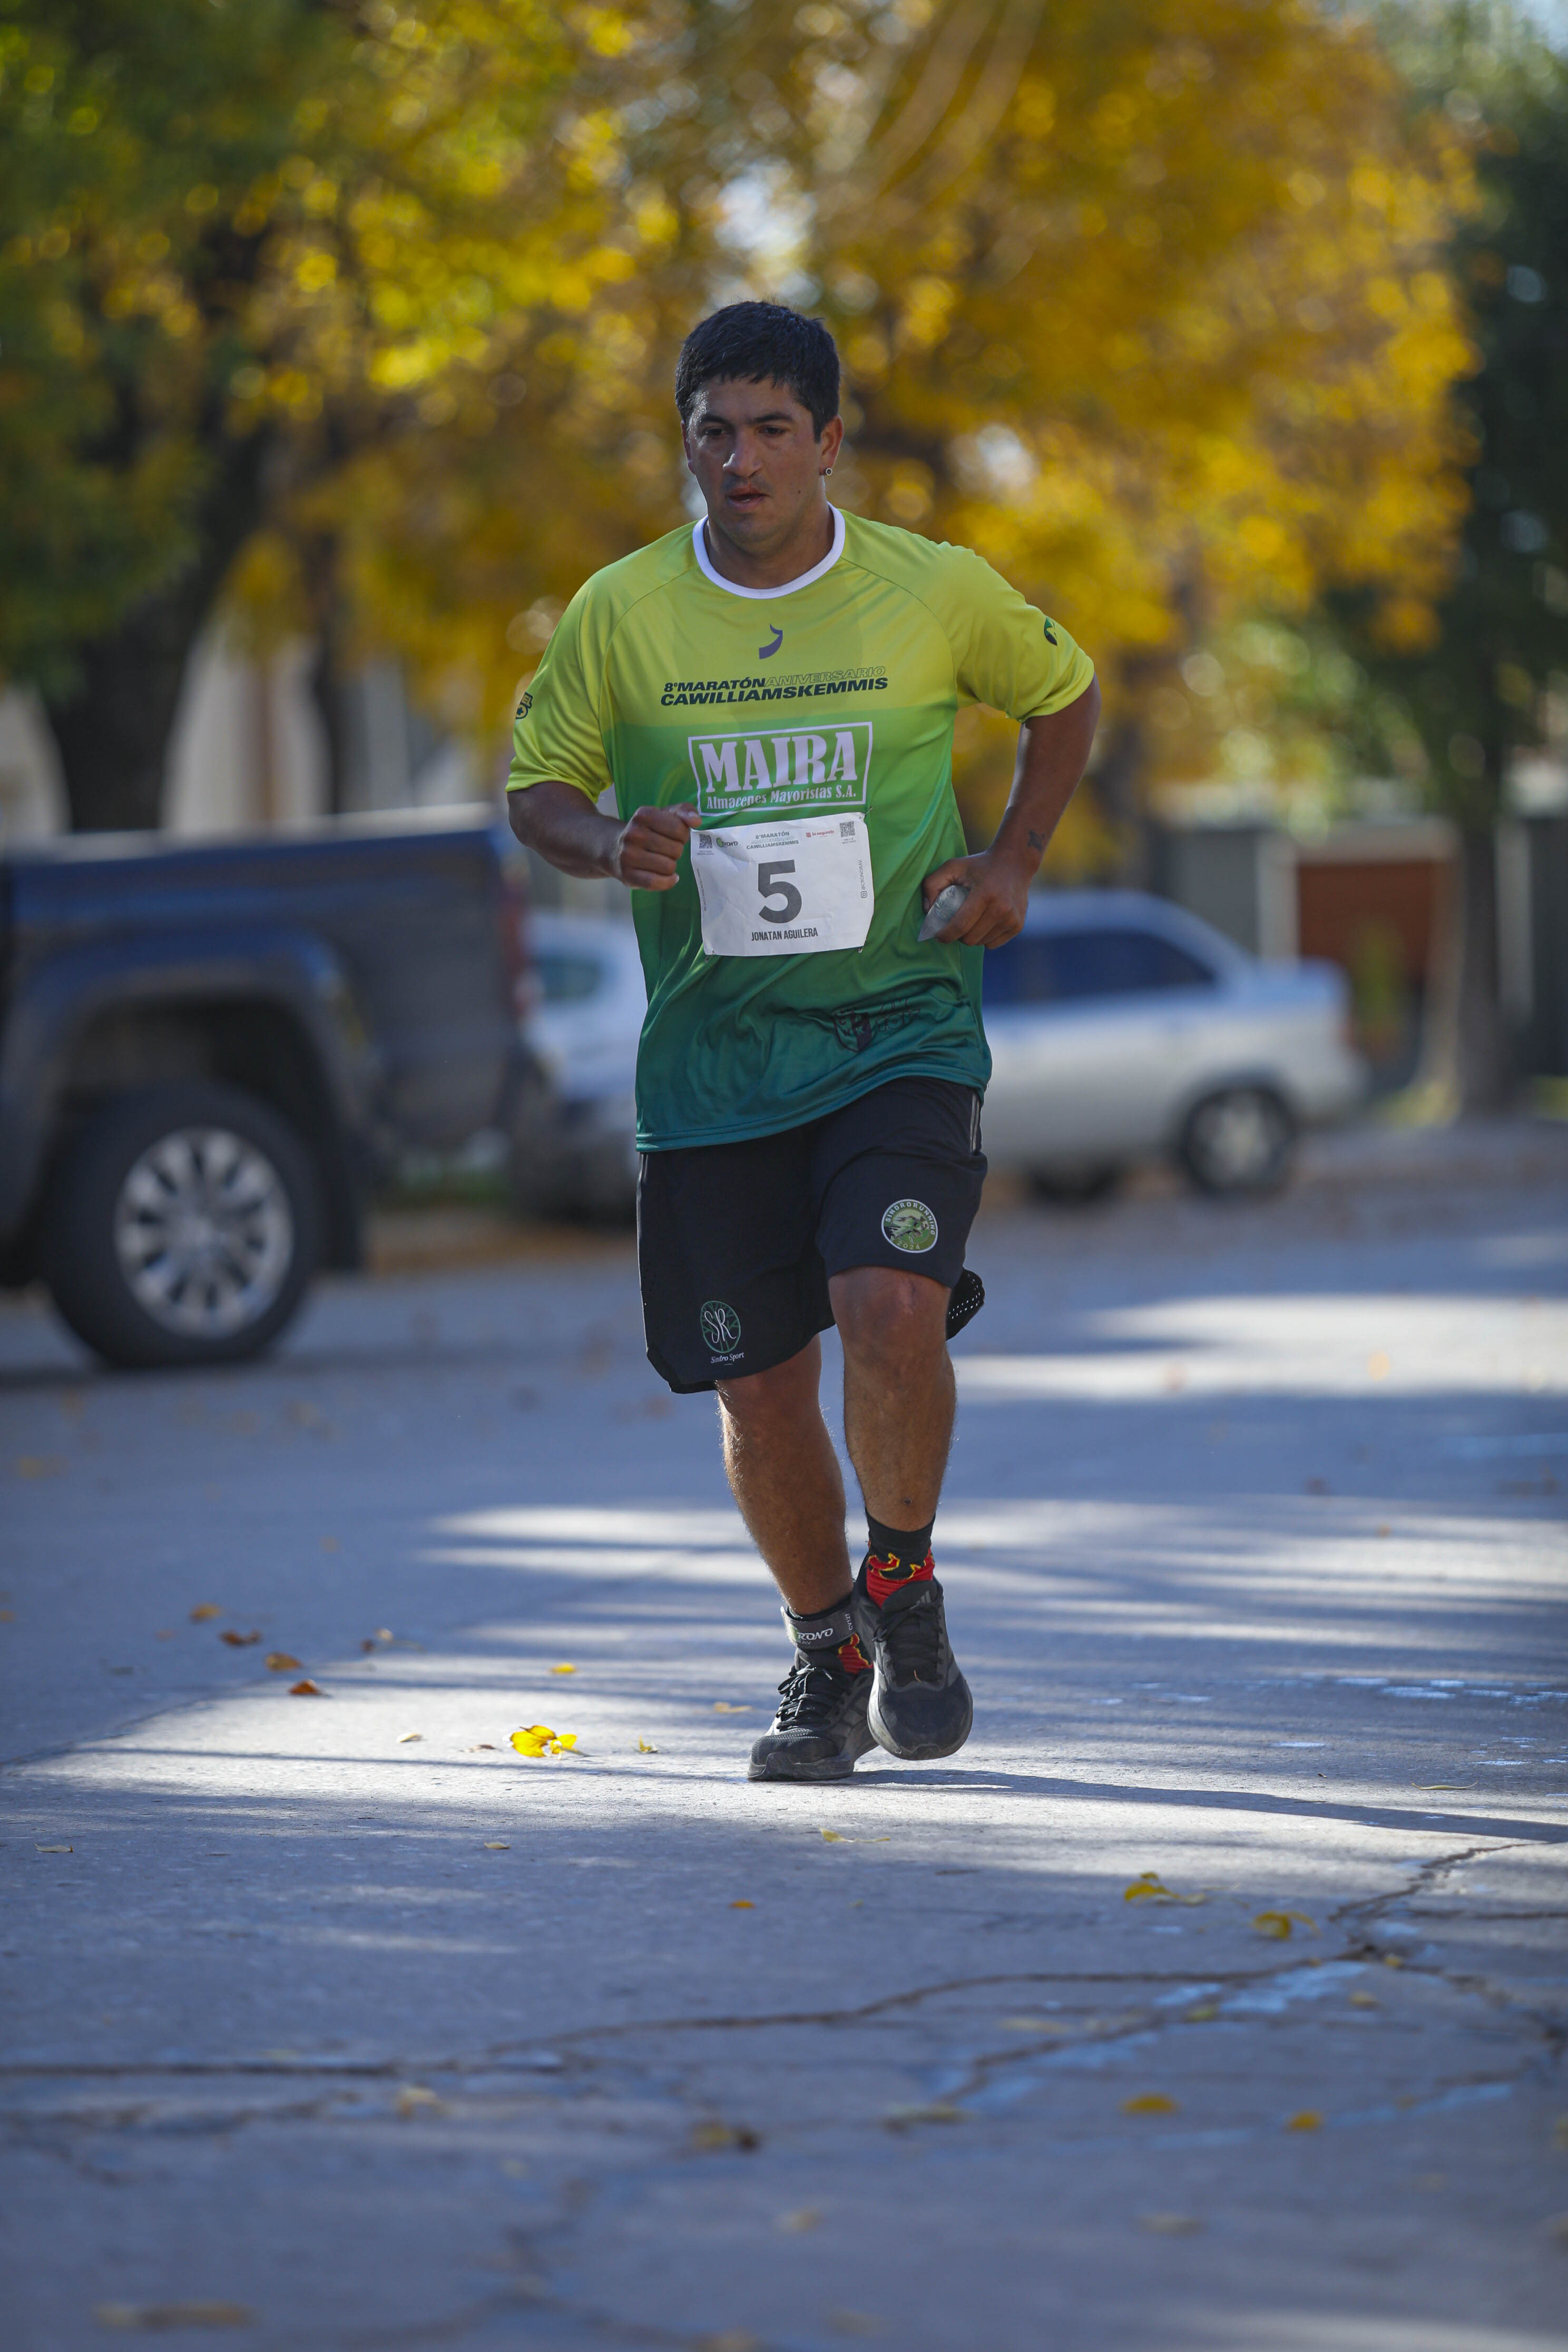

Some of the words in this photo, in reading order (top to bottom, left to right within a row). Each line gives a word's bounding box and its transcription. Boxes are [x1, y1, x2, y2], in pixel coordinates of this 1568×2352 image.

[765, 666, 886, 687] ANIVERSARIO
[661, 677, 888, 706] CAWILLIAMSKEMMIS
[699, 731, 858, 793] MAIRA
[707, 795, 767, 810] Almacenes
[770, 786, 832, 804] Mayoristas
[836, 785, 856, 798] S.A.
[746, 839, 799, 850] CAWILLIAMSKEMMIS
[758, 859, 802, 924] 5
[751, 930, 782, 942] JONATAN
[783, 927, 818, 939] AGUILERA
[885, 1201, 936, 1236] SINDRORUNNING
[897, 1240, 920, 1250] 2024
[730, 1351, 744, 1362] Sport
